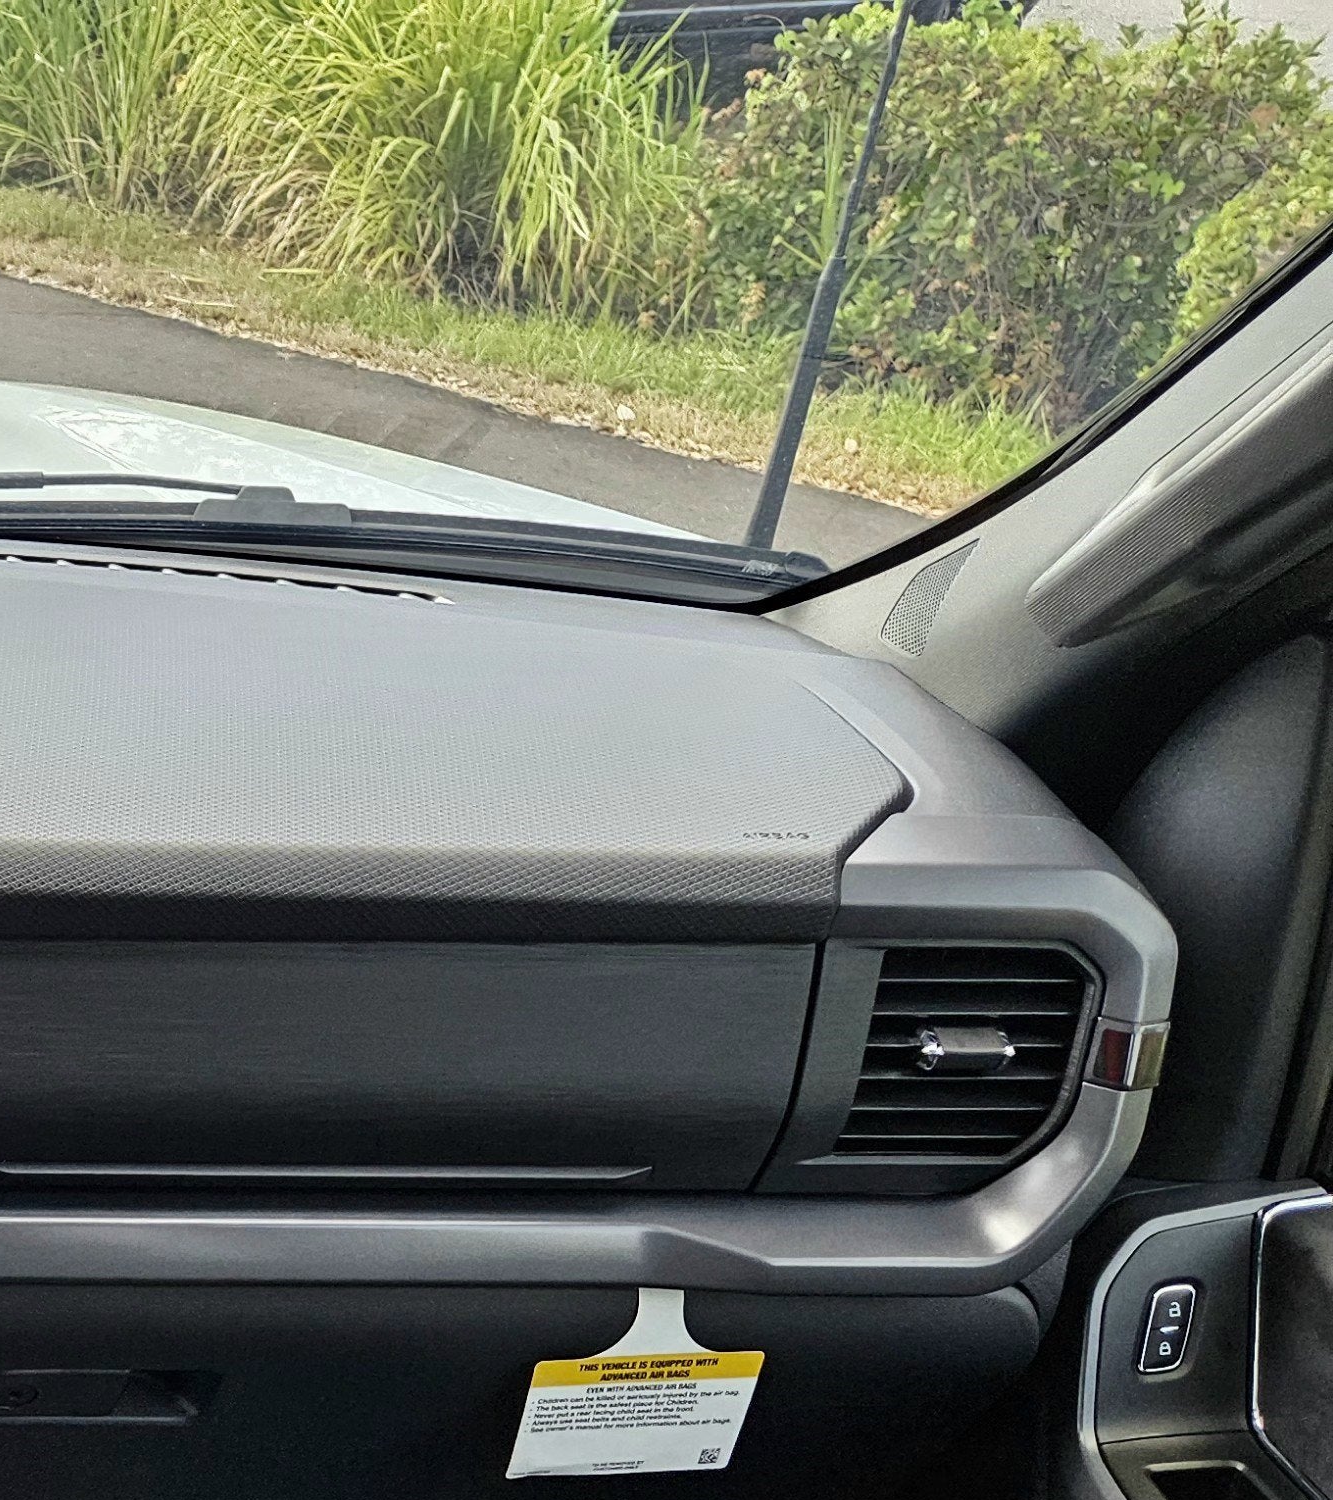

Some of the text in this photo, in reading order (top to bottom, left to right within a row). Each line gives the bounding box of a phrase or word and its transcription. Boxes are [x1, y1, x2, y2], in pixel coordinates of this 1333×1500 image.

[580, 1363, 599, 1372] THIS
[601, 1362, 636, 1370] VEHICLE
[650, 1359, 693, 1368] EQUIPPED
[696, 1358, 719, 1366] WITH
[600, 1370, 690, 1381] ADVANCED AIR BAGS
[626, 1384, 663, 1392] ADVANCED
